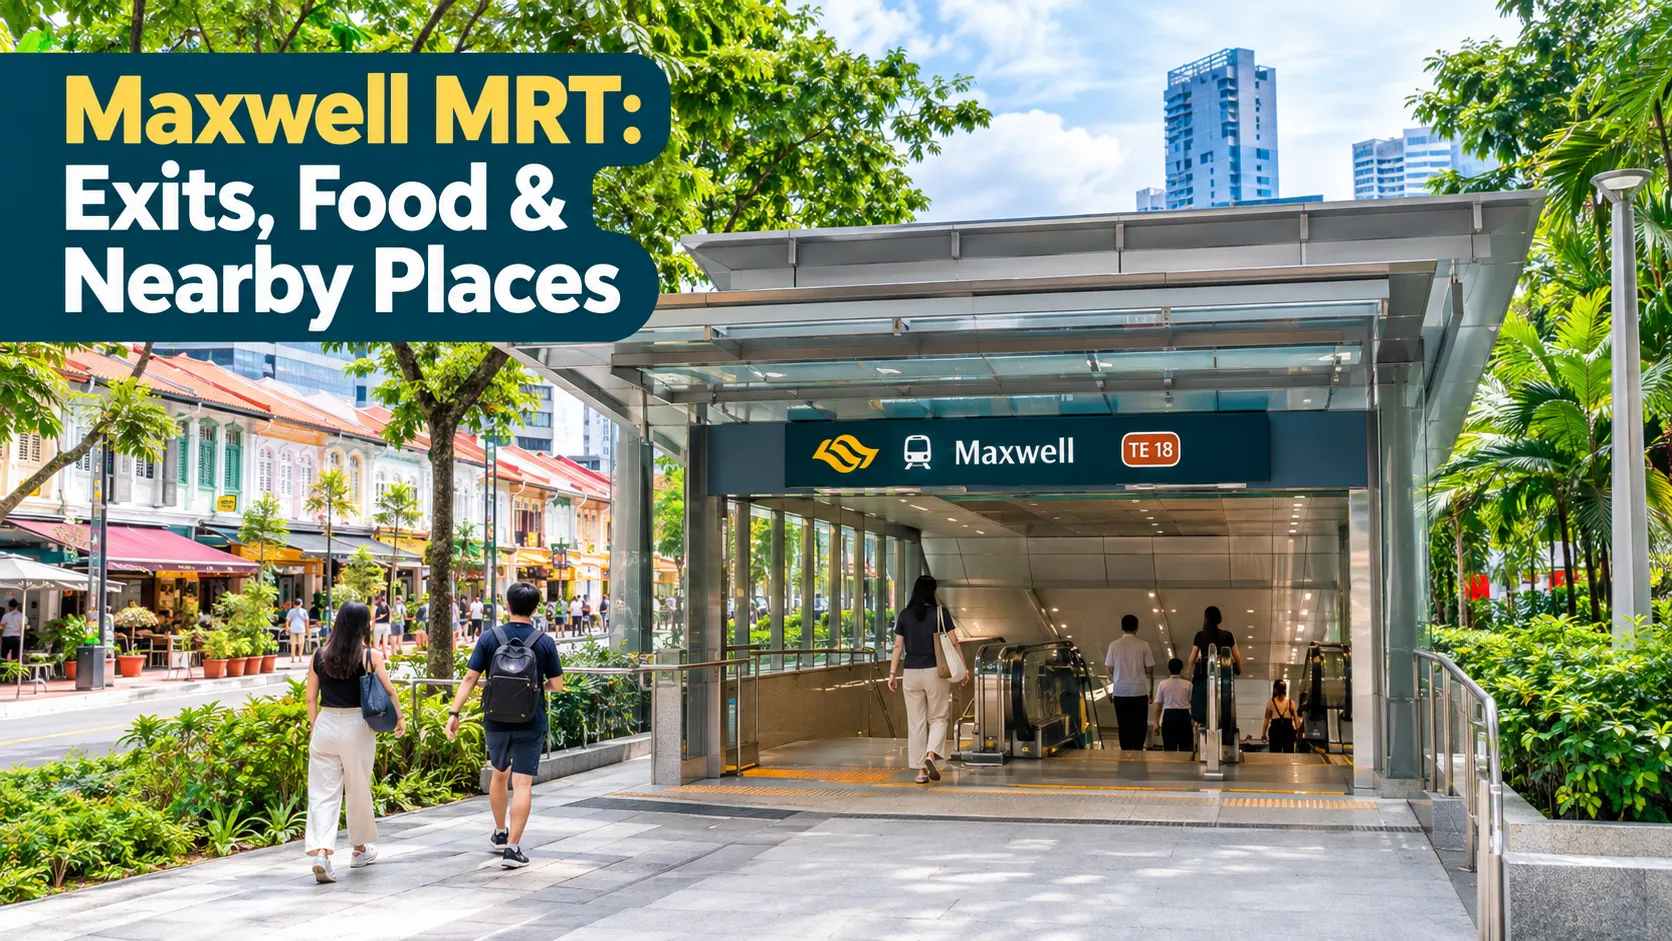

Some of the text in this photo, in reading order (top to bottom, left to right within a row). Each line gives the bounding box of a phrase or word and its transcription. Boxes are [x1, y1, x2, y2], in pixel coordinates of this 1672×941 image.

[955, 436, 1174, 465] Maxwell TE 18
